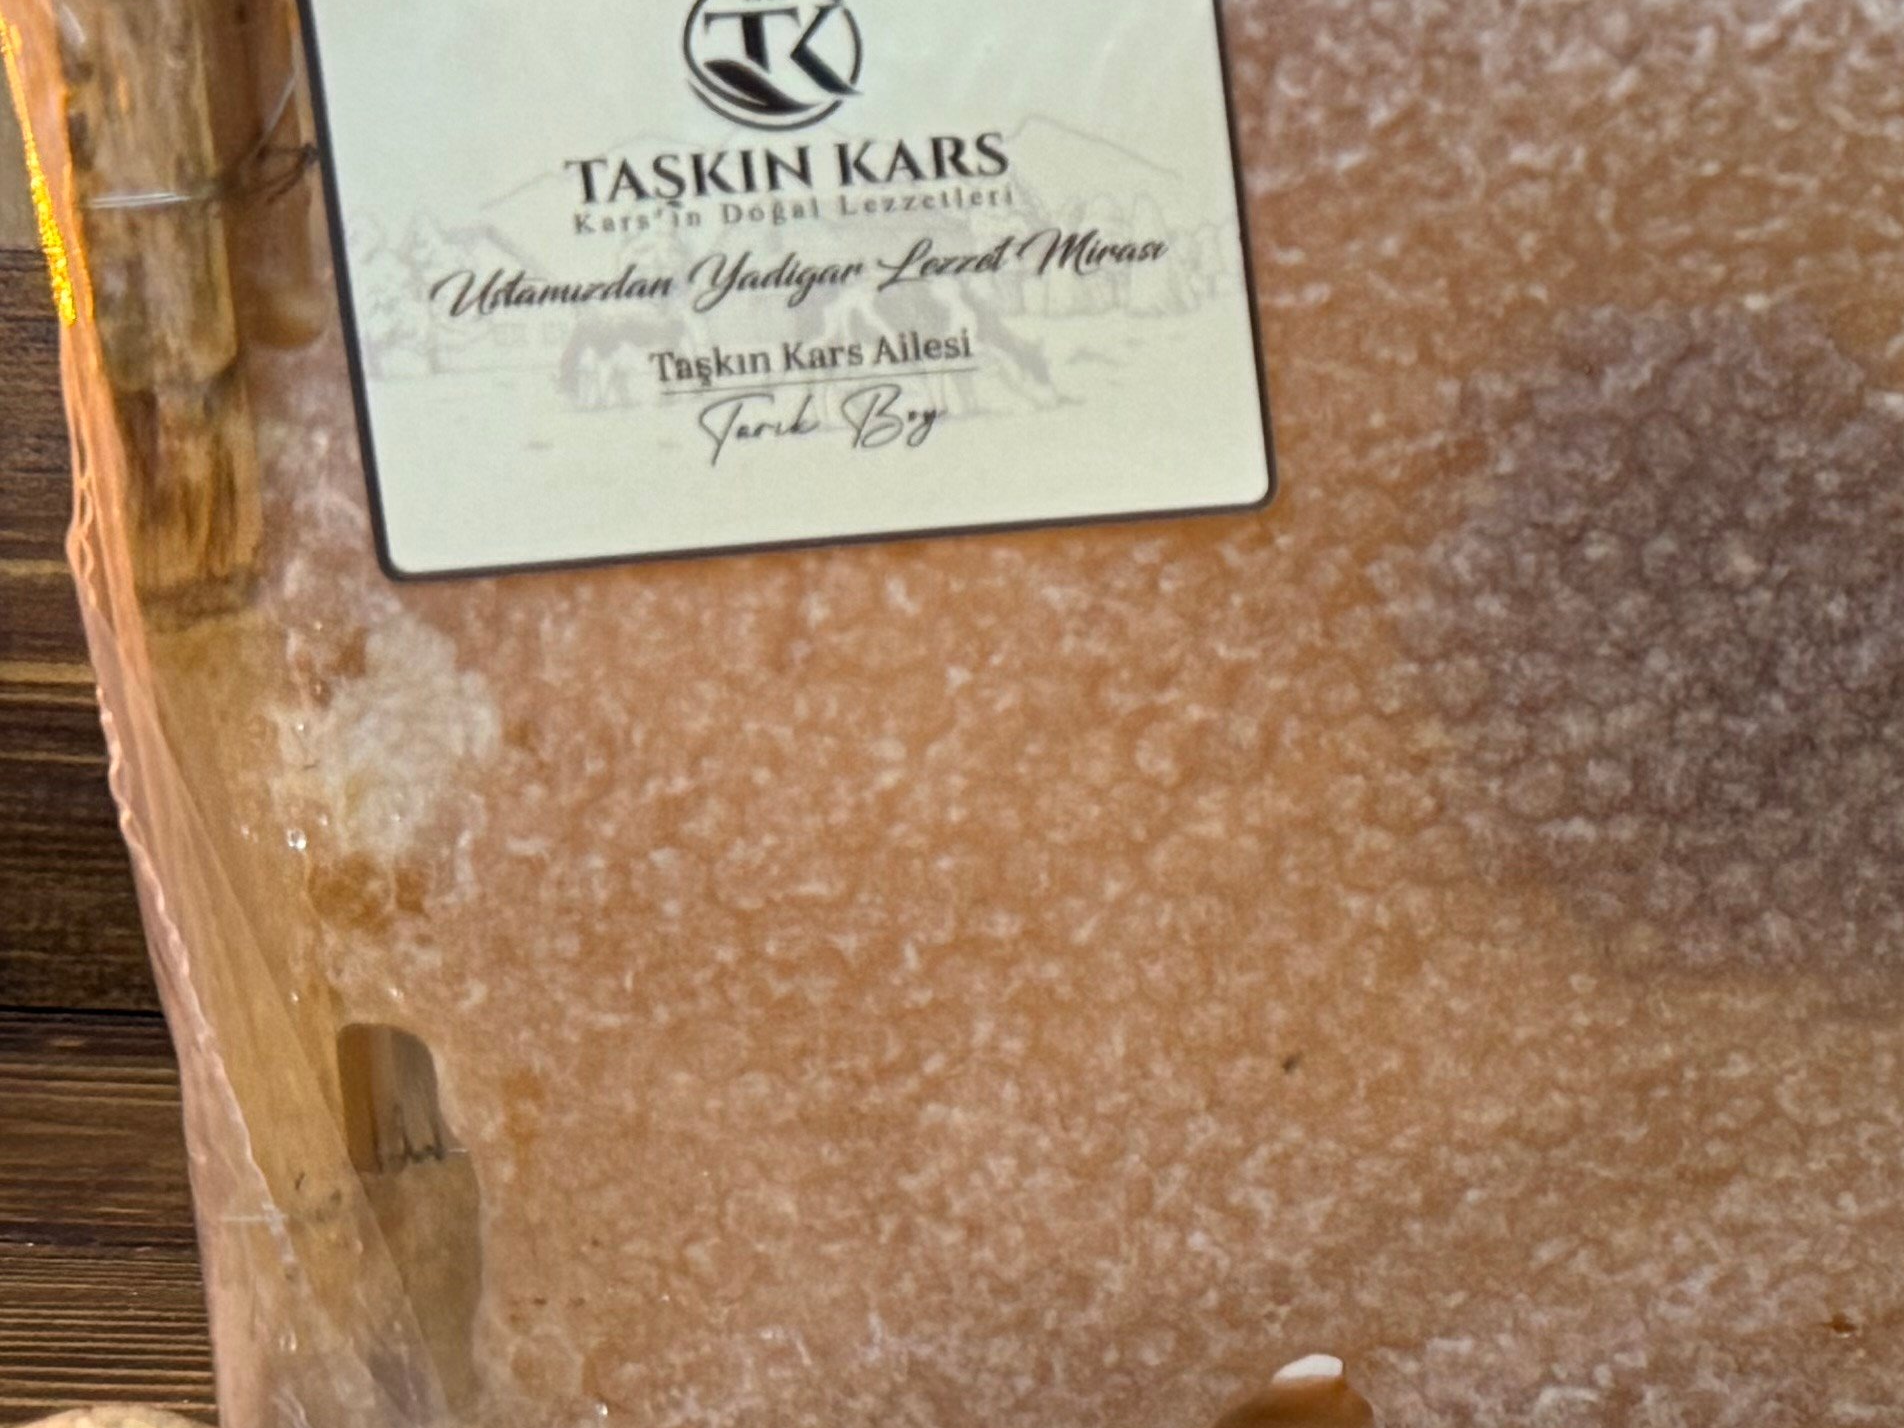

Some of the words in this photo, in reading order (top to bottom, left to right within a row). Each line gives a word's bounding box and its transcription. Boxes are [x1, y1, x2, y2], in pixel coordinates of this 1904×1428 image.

[564, 143, 812, 208] TAŞKIN
[835, 132, 1010, 186] KARS
[723, 196, 819, 227] Doğal
[840, 182, 1015, 216] Lezzetleri
[783, 339, 864, 371] Kars
[872, 328, 972, 364] Ailesi
